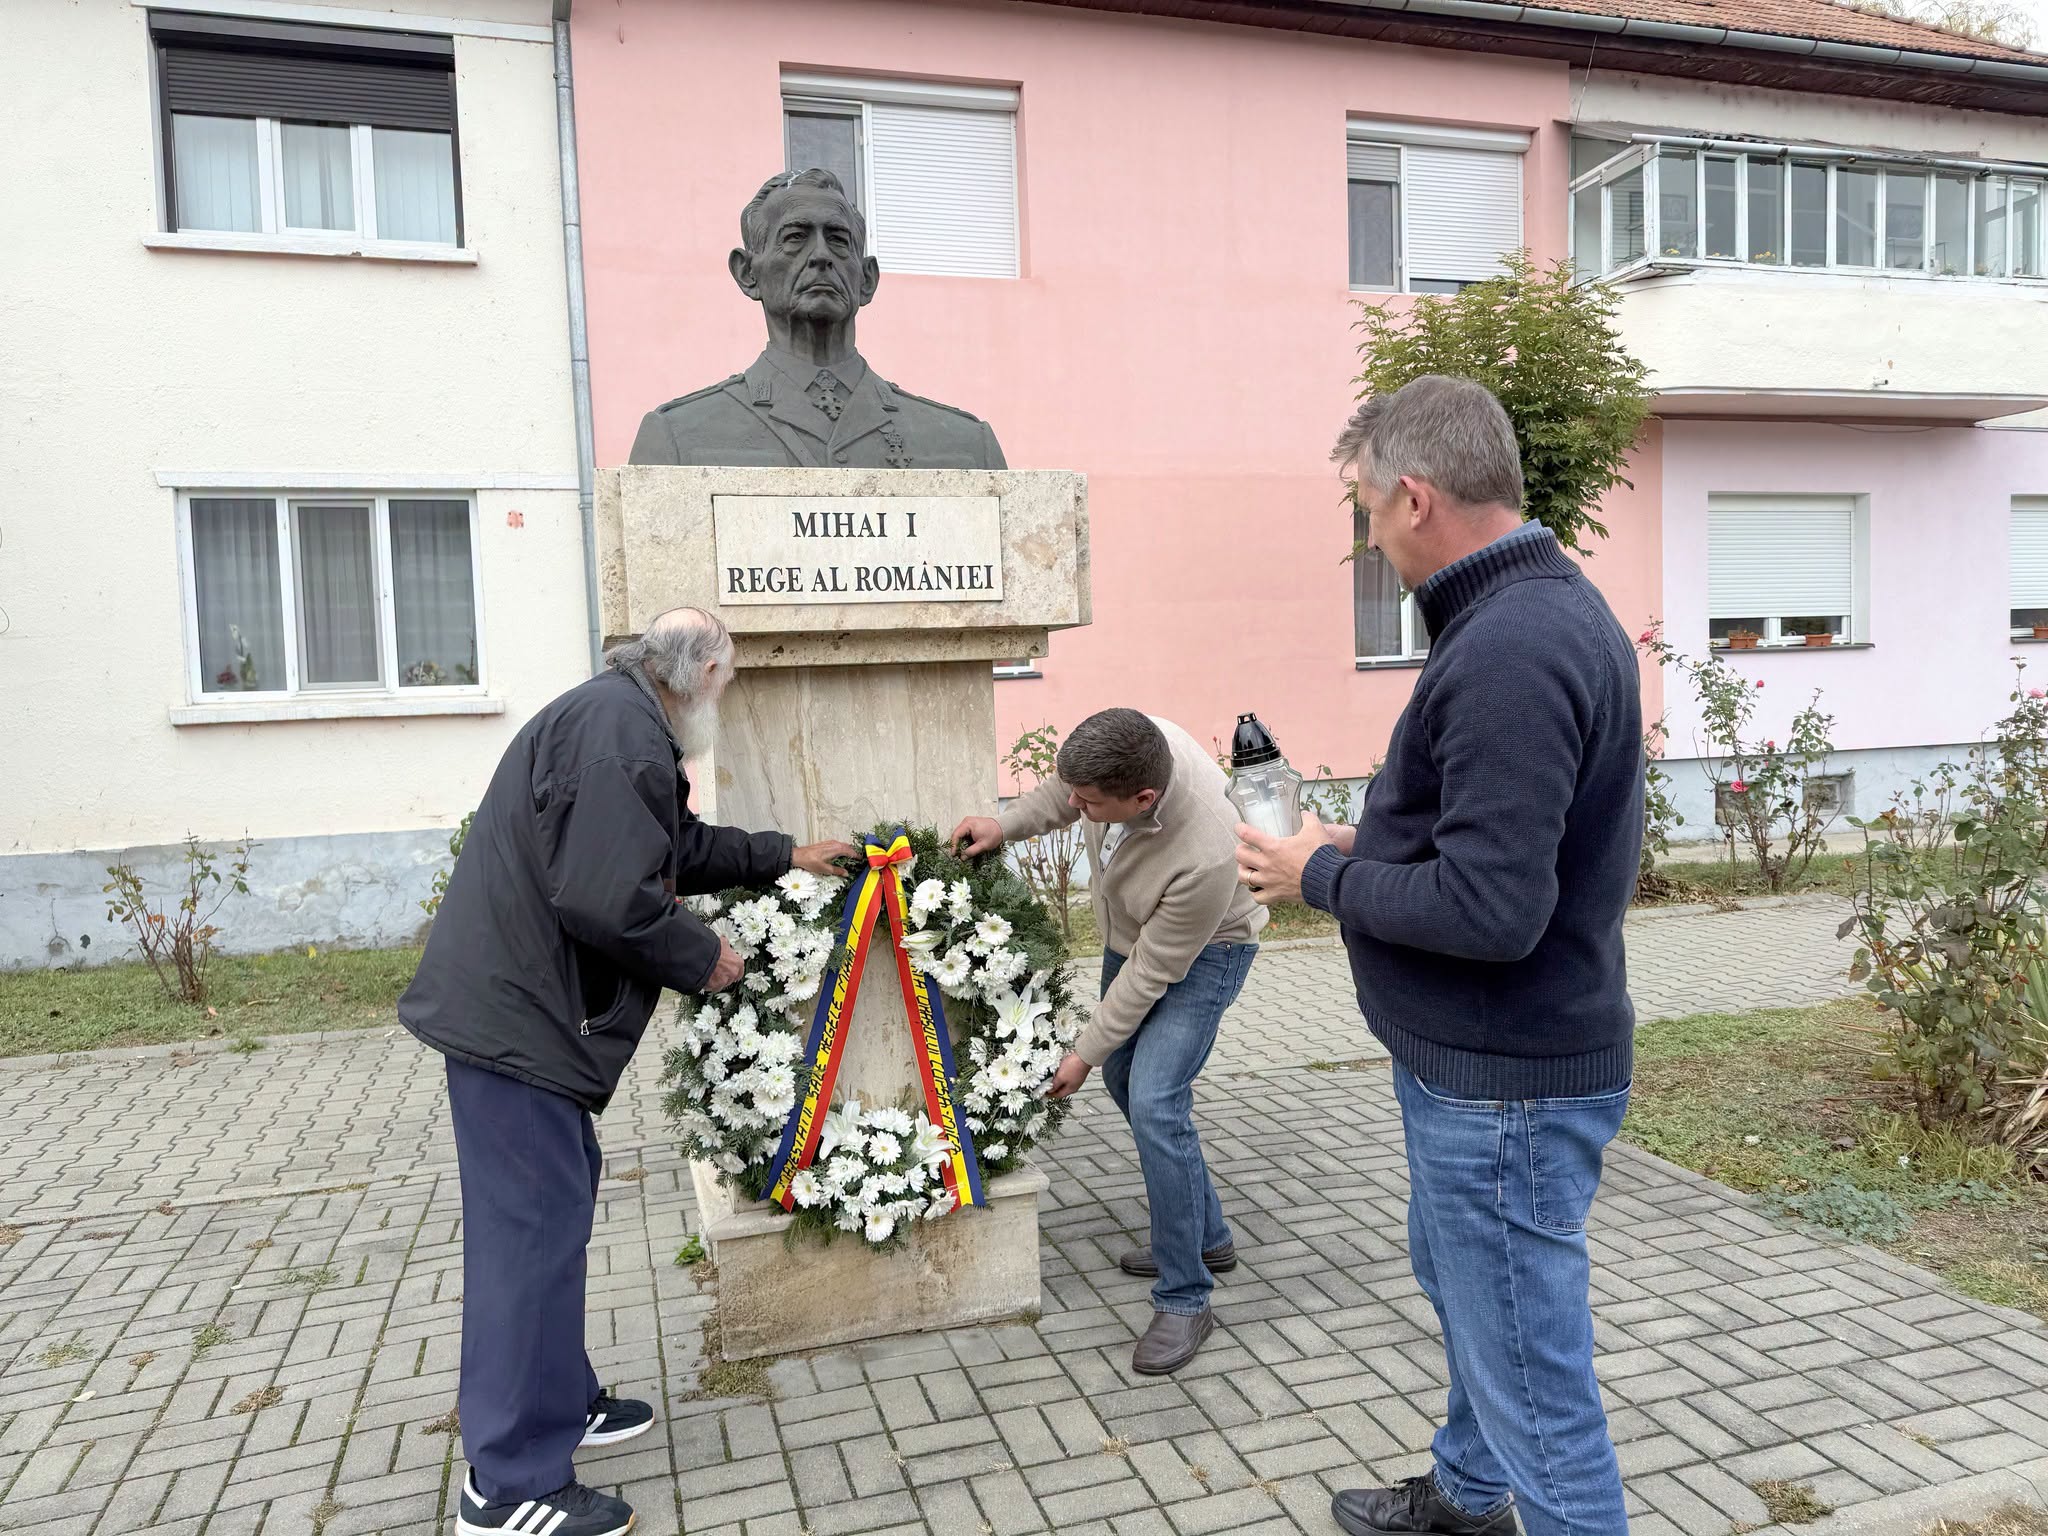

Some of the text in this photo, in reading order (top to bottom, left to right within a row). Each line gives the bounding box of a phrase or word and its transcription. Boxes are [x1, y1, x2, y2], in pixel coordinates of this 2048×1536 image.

[792, 512, 917, 538] MIHAI I
[727, 560, 994, 593] REGE AL ROMÂNIEI
[819, 998, 843, 1054] REGELE
